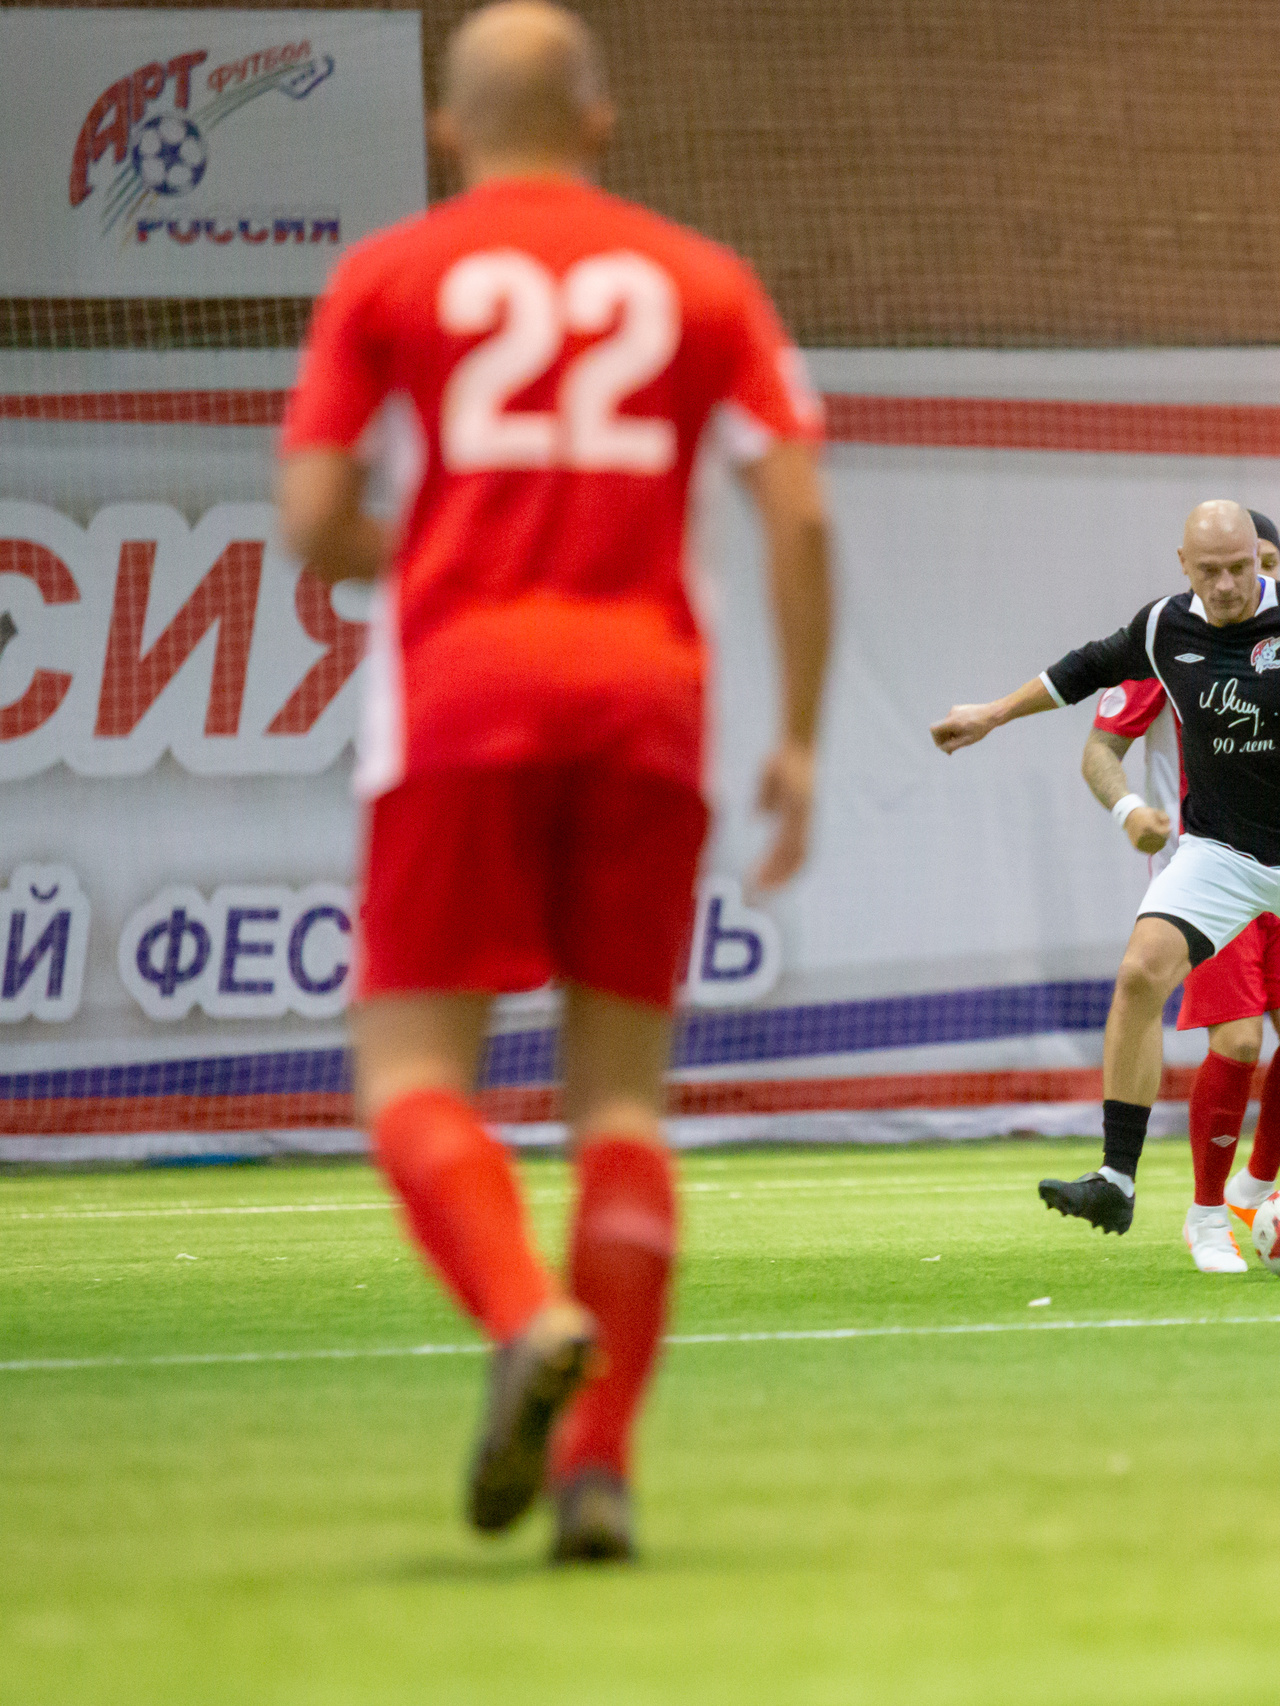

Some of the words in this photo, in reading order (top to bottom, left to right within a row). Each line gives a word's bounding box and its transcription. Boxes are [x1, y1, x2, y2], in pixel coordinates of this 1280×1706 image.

[69, 49, 208, 207] АРТ
[437, 248, 682, 475] 22
[1213, 737, 1235, 755] 90
